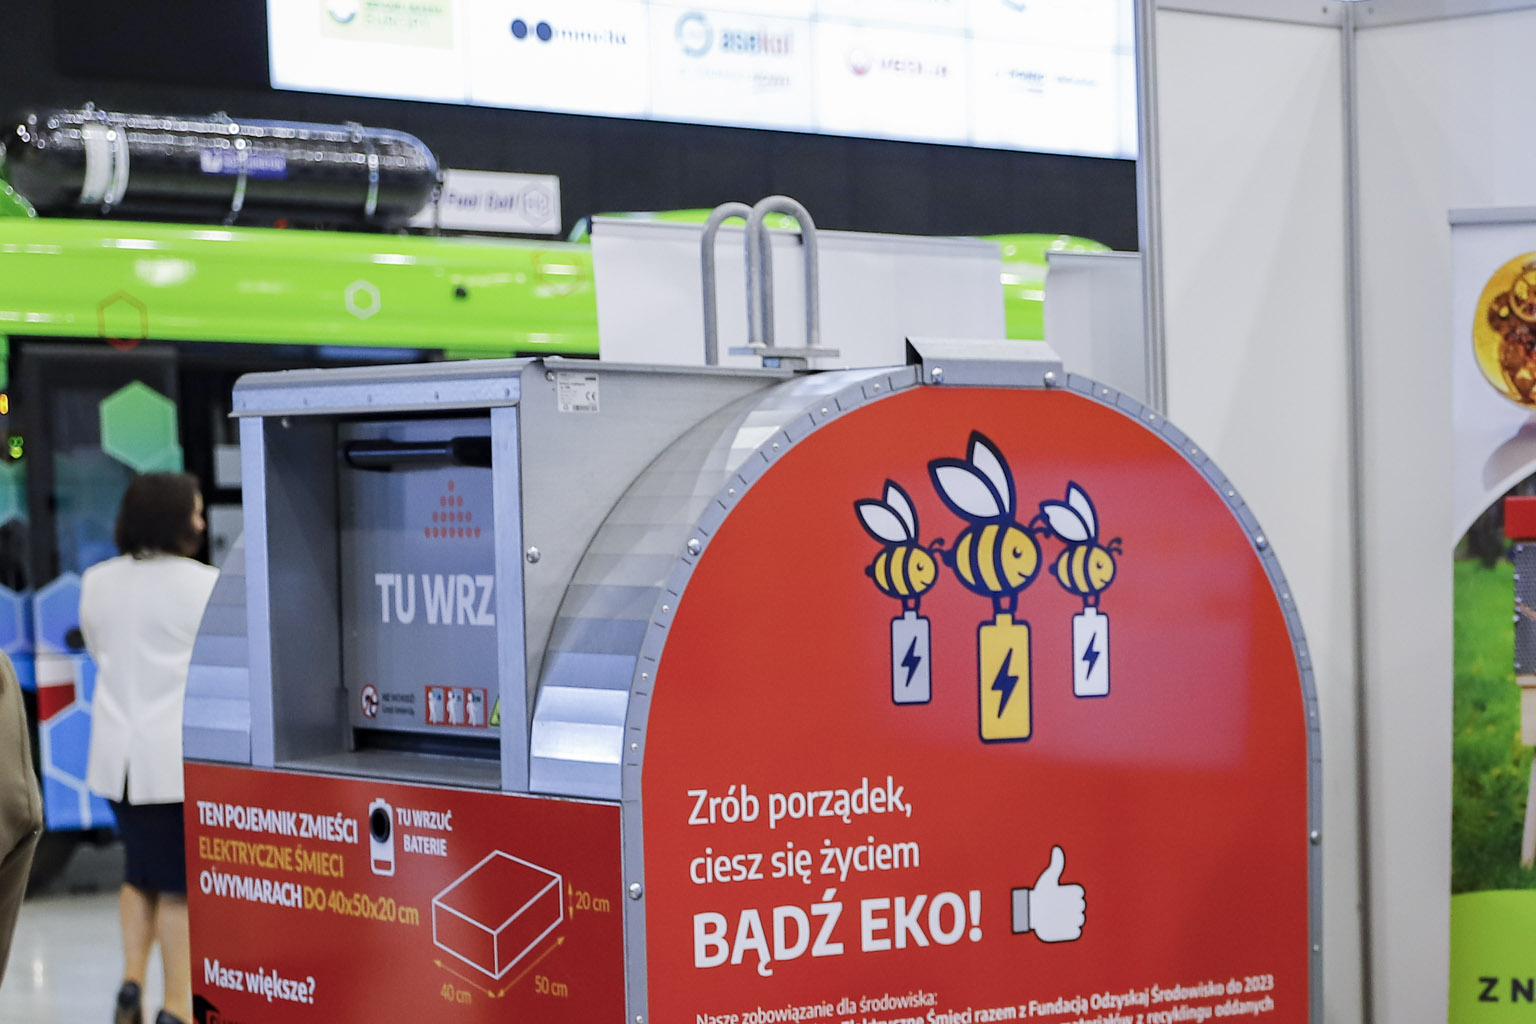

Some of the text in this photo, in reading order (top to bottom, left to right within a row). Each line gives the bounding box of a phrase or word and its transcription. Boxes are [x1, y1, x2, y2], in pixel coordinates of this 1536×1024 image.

[375, 573, 415, 624] TU
[197, 801, 358, 844] TEN POJEMNIK ZMIEŚCI
[397, 807, 452, 831] TU WRZUĆ
[687, 775, 912, 829] Zrób porządek,
[199, 836, 344, 878] ELEKTRYCZNE ŚMIECI
[403, 834, 447, 857] BATERIE
[689, 836, 920, 884] ciesz się życiem
[200, 870, 419, 926] O WYMIARACH DO 40x50x20 cm
[575, 891, 610, 912] 20 cm
[693, 888, 983, 977] BĄDŹ EKO!
[204, 957, 315, 1004] Masz większe?
[440, 983, 471, 1005] 40 cm
[535, 975, 568, 998] 50 cm
[974, 1006, 1016, 1023] razem
[1019, 1005, 1027, 1018] z
[1029, 996, 1088, 1017] Fundacją
[1090, 988, 1149, 1012] Odzyskaj
[1151, 979, 1224, 1003] Środowisko
[1226, 978, 1242, 994] do
[1244, 974, 1274, 993] 2023
[1478, 977, 1499, 1003] Z
[836, 997, 857, 1015] dla
[859, 989, 938, 1013] środowiska:
[1214, 995, 1274, 1018] oddanych
